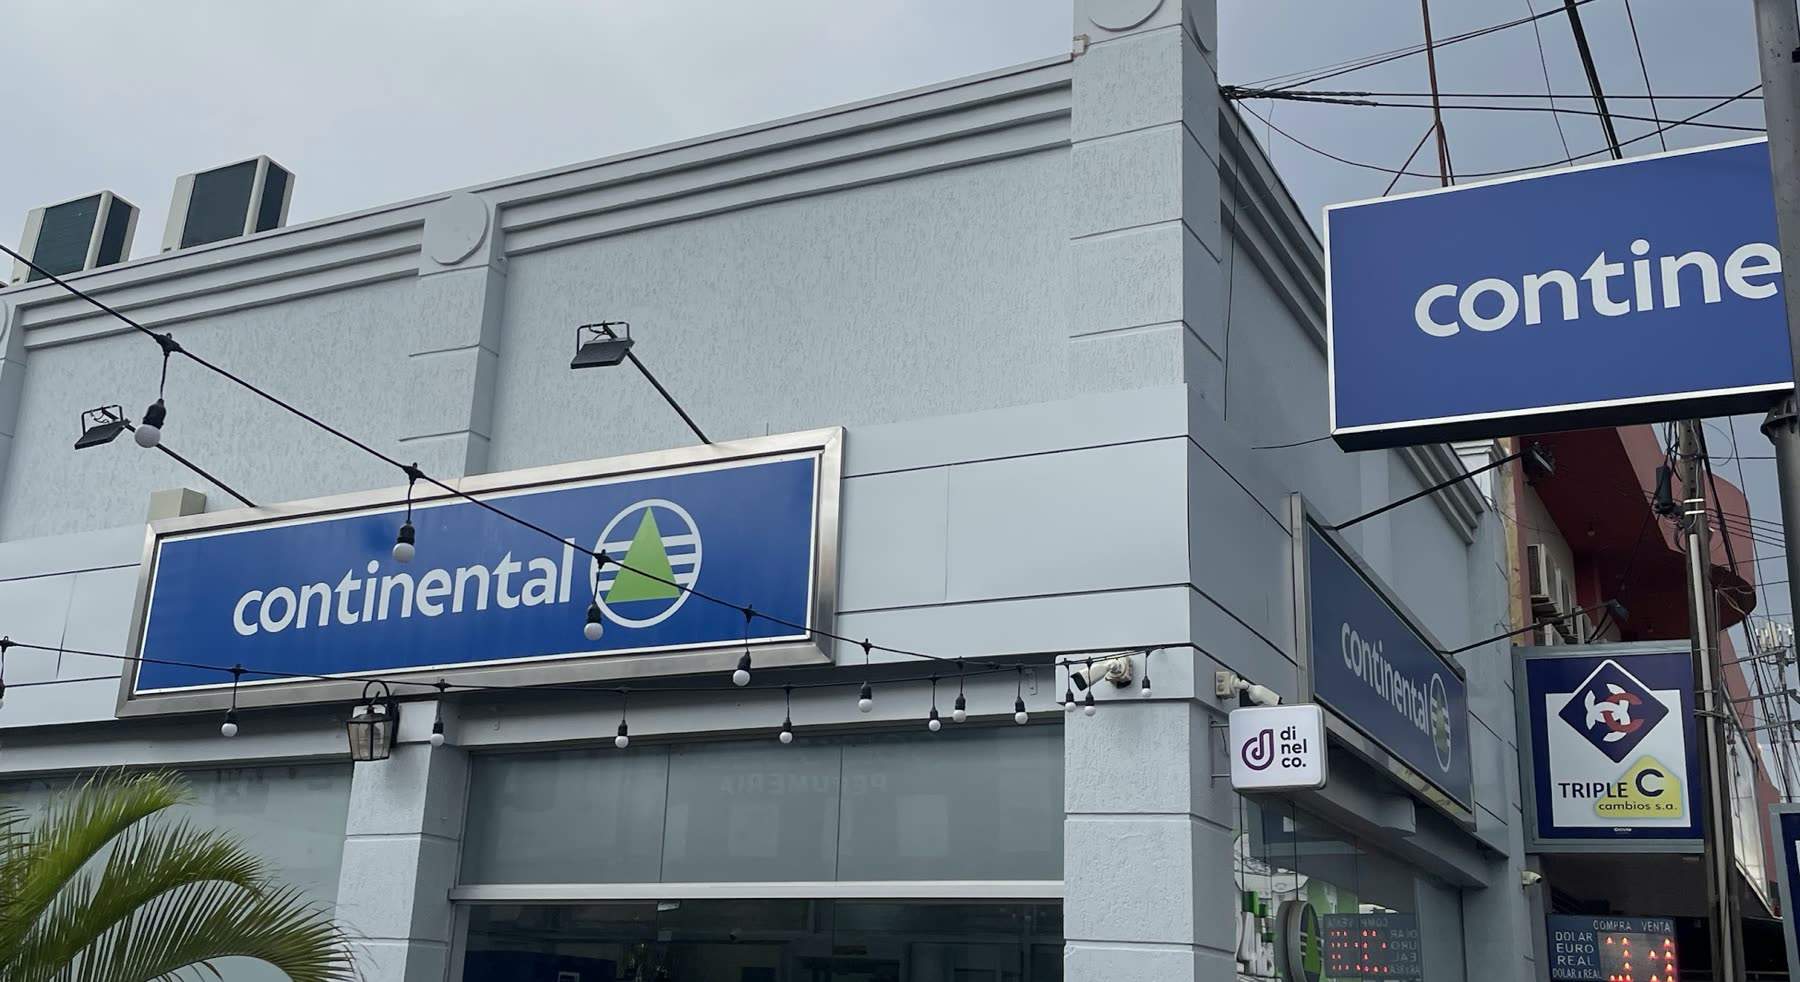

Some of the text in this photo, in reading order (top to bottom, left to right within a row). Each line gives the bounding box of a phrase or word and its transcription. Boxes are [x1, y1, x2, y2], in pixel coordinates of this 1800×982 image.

[1414, 239, 1782, 337] contine
[233, 538, 575, 636] continental
[1341, 622, 1430, 736] continental
[1280, 726, 1296, 740] di
[1281, 738, 1307, 754] nel
[1281, 757, 1307, 768] co.
[1558, 768, 1665, 798] TRIPLE C
[1598, 801, 1678, 811] cambios s.a.
[1593, 919, 1672, 933] COMPRA VENTA
[1555, 931, 1593, 942] DOLAR
[1556, 943, 1595, 954] EURO
[1557, 955, 1595, 967] REAL
[1552, 967, 1577, 979] DOLAR
